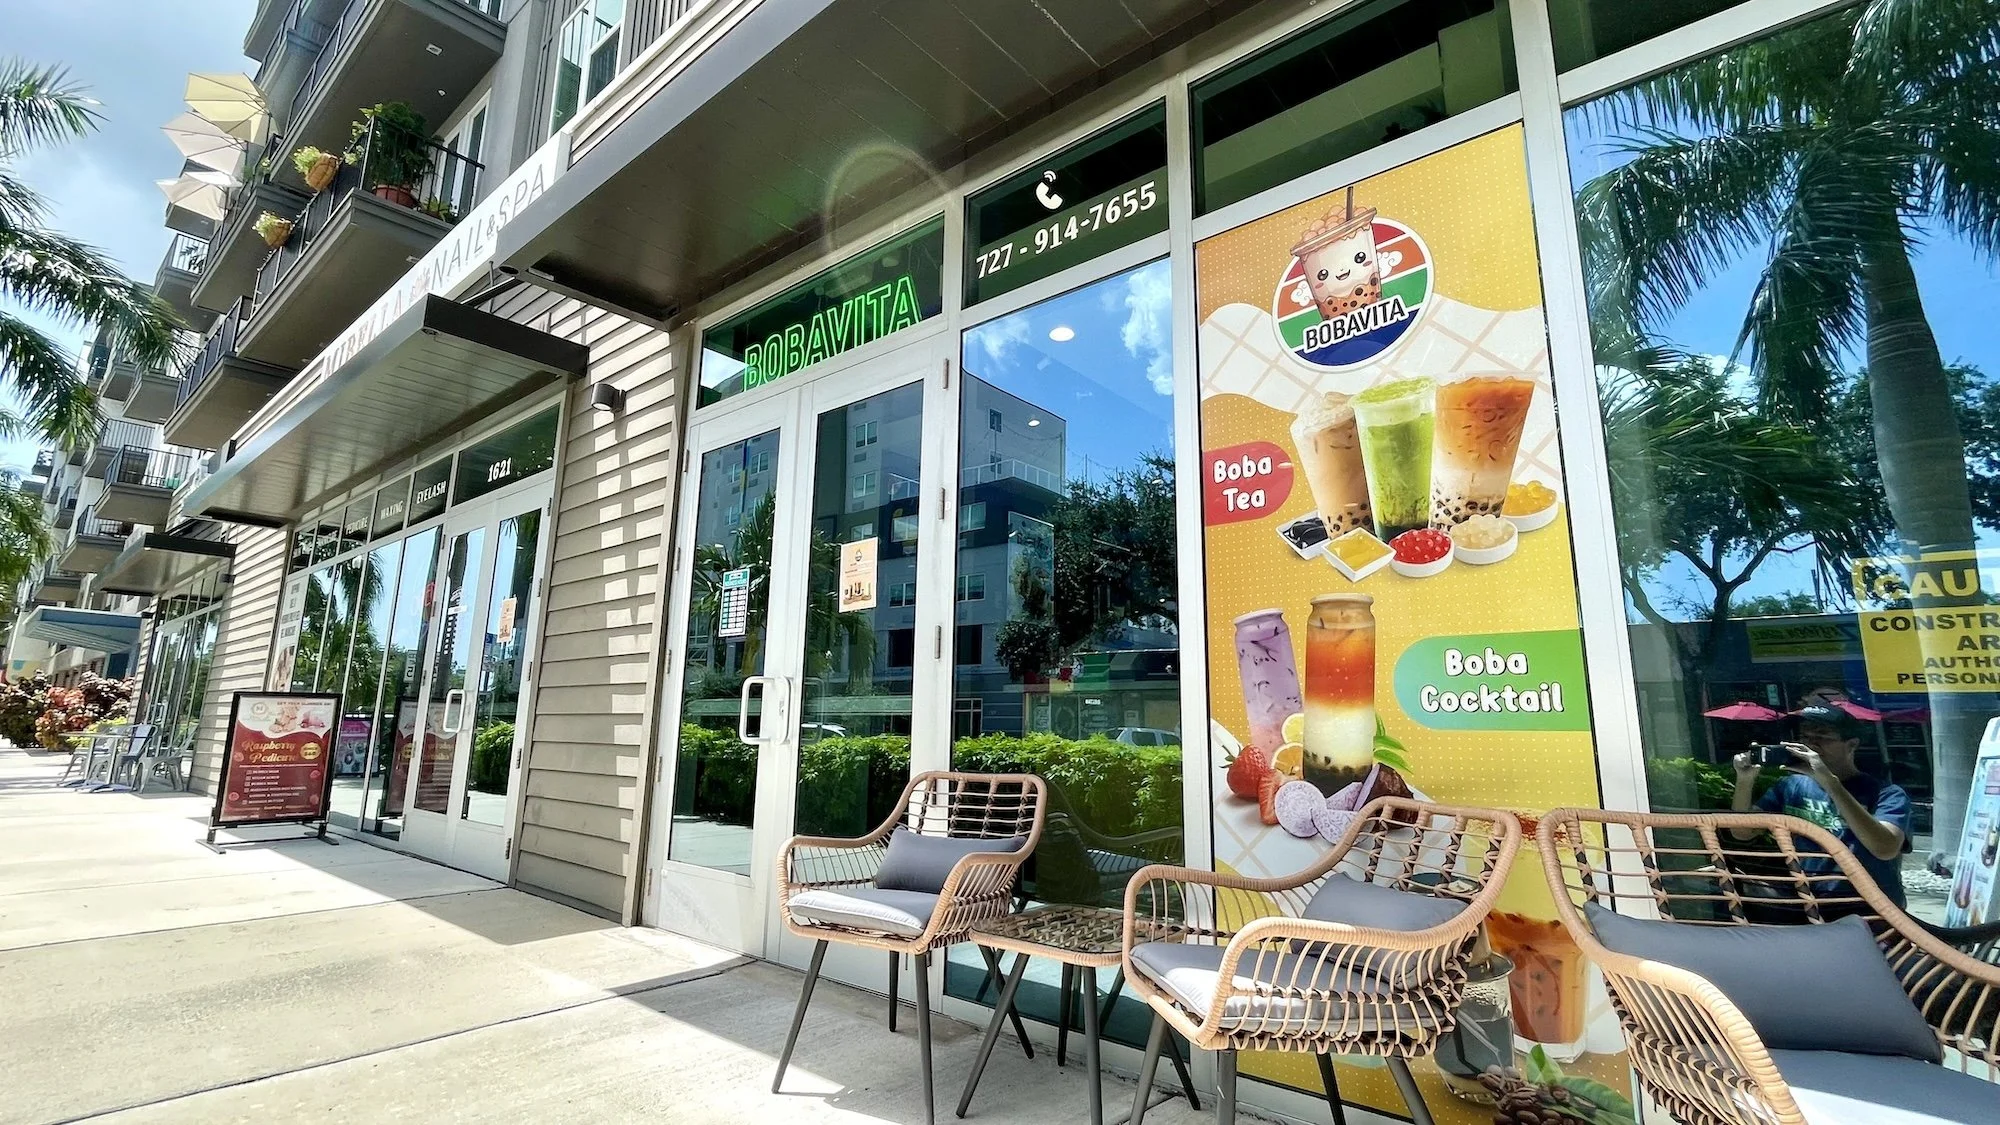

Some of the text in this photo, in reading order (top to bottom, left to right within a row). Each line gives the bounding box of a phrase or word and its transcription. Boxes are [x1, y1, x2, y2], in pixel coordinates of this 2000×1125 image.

[976, 242, 1014, 279] 727
[1034, 181, 1157, 255] 914-7655
[743, 275, 922, 393] BOBAVITA
[1306, 298, 1405, 350] BOBAVITA
[487, 457, 512, 483] 1621
[1213, 454, 1272, 484] Boba
[416, 480, 447, 504] EYELASH
[1222, 487, 1266, 512] Tea
[380, 501, 404, 520] WAXING
[1873, 568, 1980, 600] CAU
[1870, 612, 2000, 632] CONSTR
[1444, 647, 1528, 676] Boba
[1420, 681, 1564, 713] Cocktail
[241, 740, 296, 752] Raspberry
[248, 752, 297, 764] Pedicure
